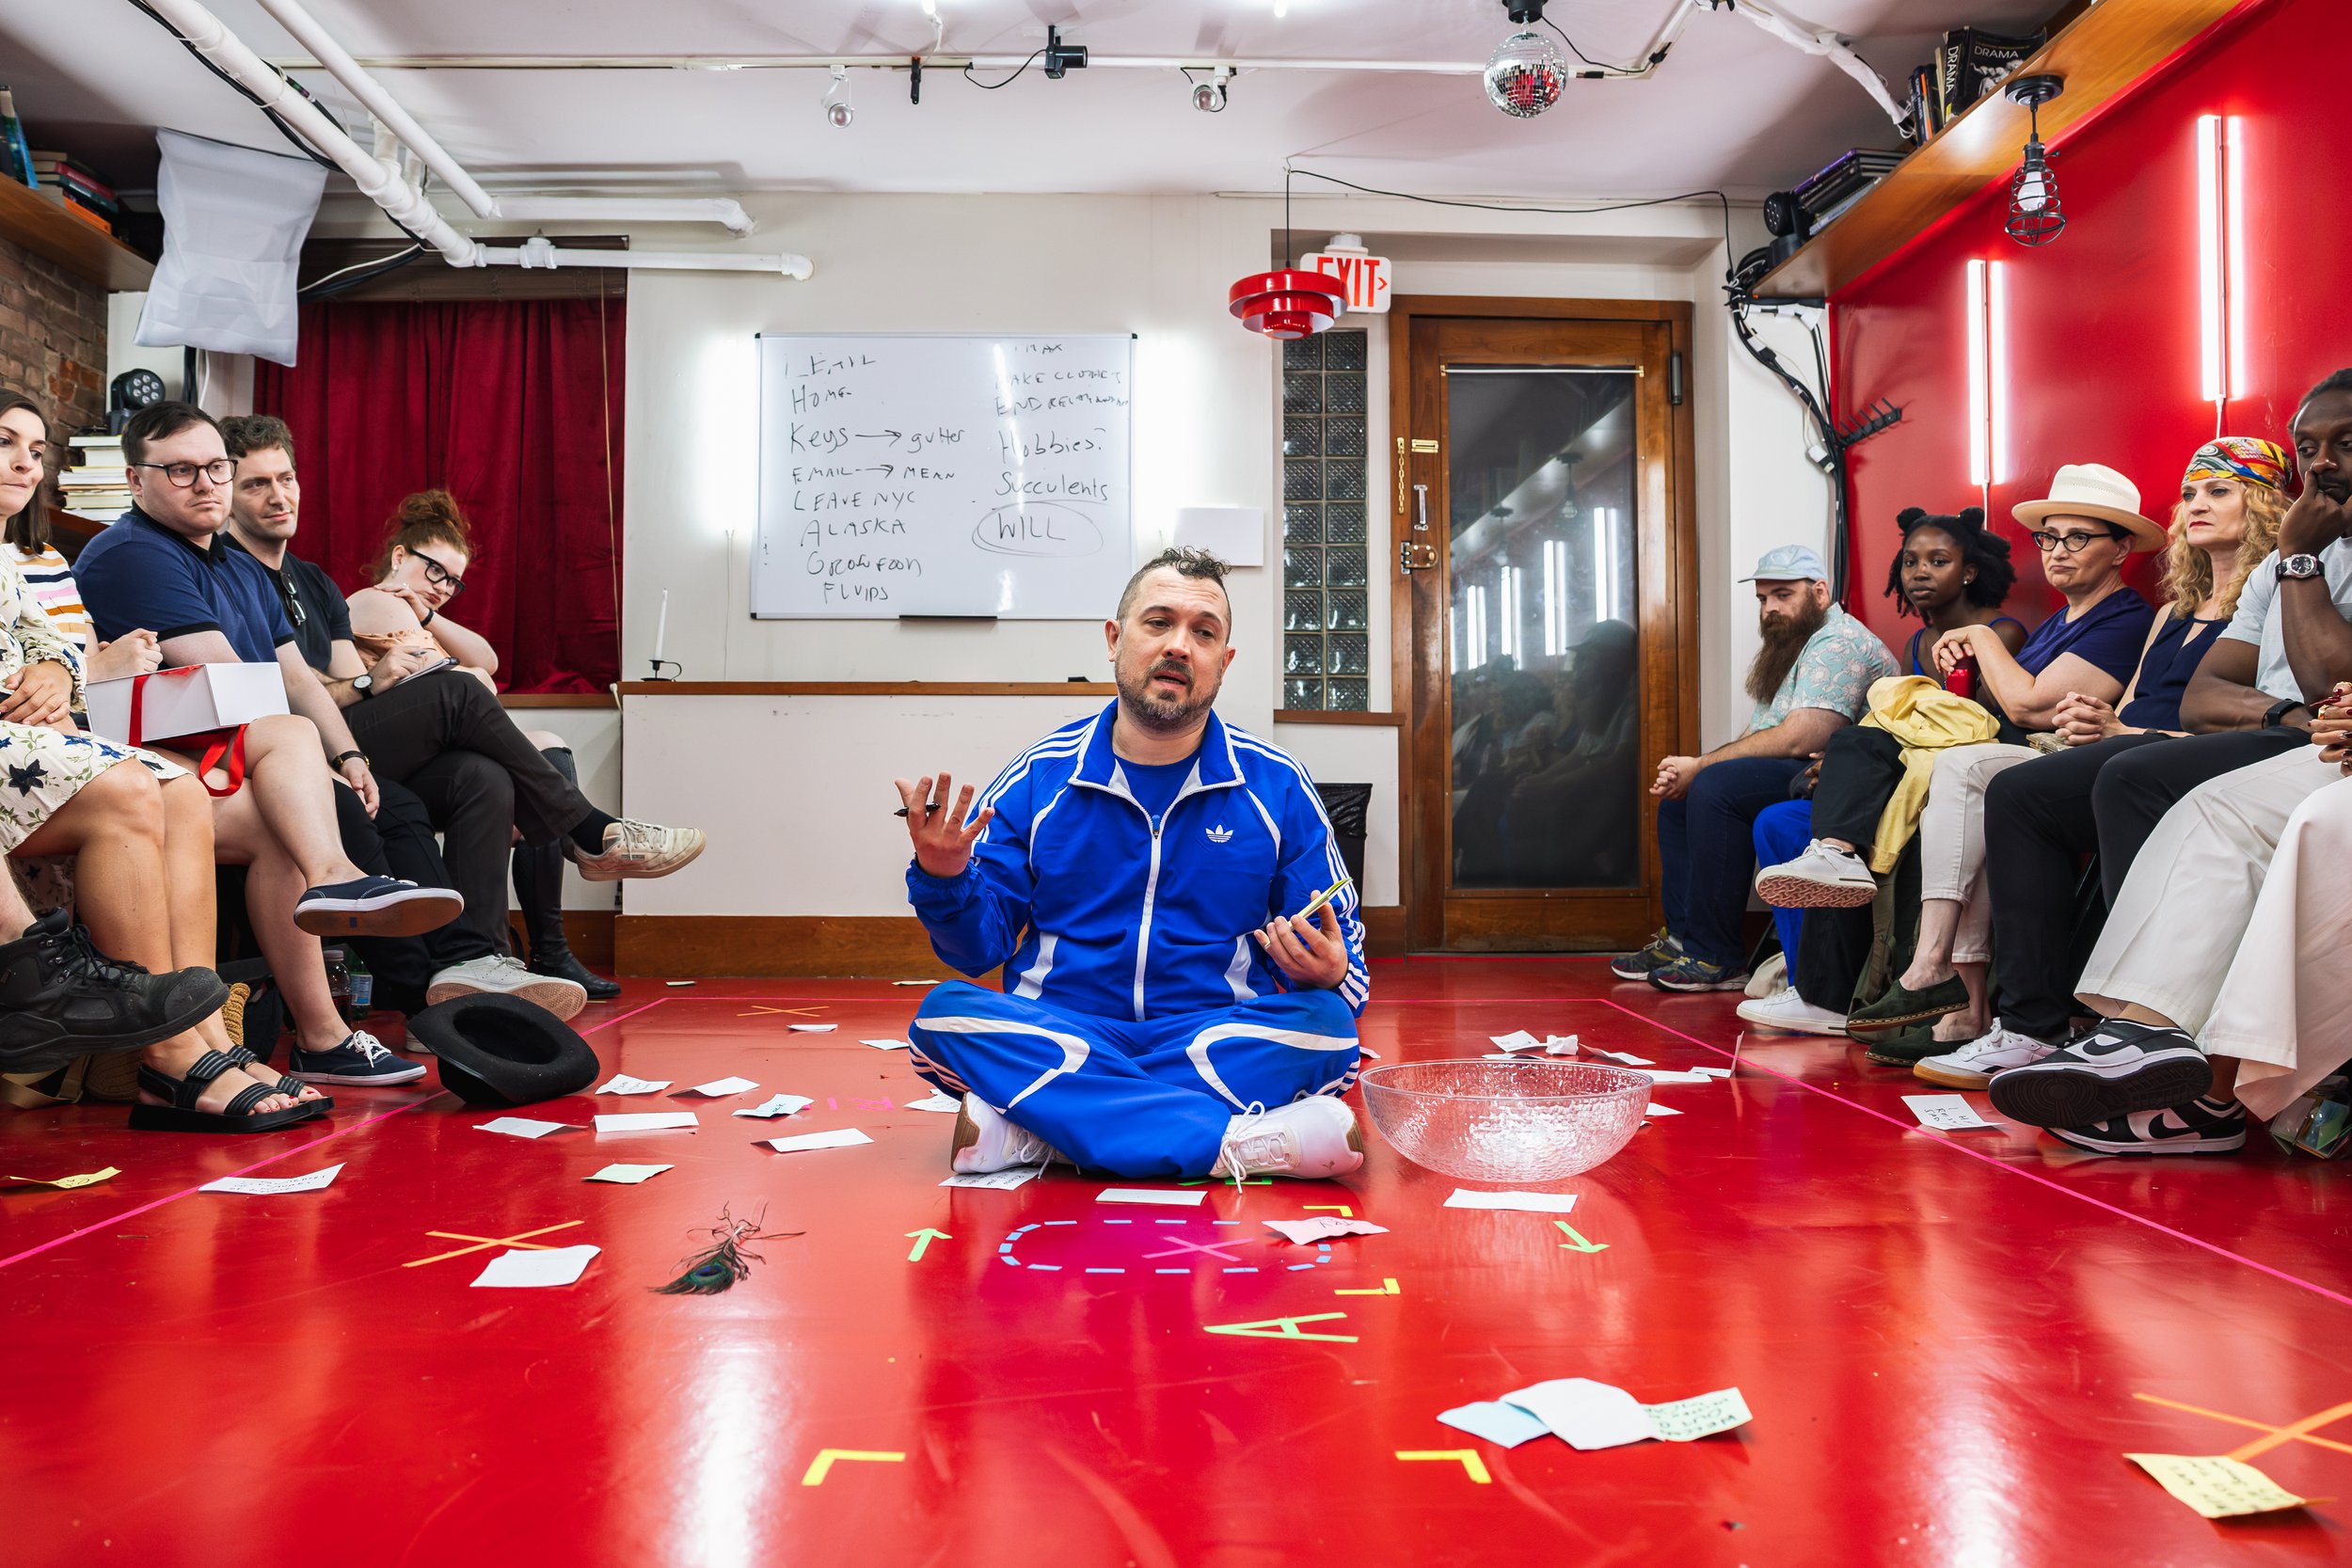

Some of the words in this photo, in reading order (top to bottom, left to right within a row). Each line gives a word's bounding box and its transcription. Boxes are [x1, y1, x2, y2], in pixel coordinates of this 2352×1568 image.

[1974, 46, 2019, 59] DRAMA
[1946, 46, 1959, 94] DRAMA
[995, 372, 1046, 389] AKE
[790, 421, 849, 454] Keys
[994, 470, 1108, 501] Succulents
[793, 490, 862, 512] LEAVE
[873, 490, 916, 511] NYC
[800, 517, 907, 547] ALASKA
[997, 512, 1067, 541] WILL
